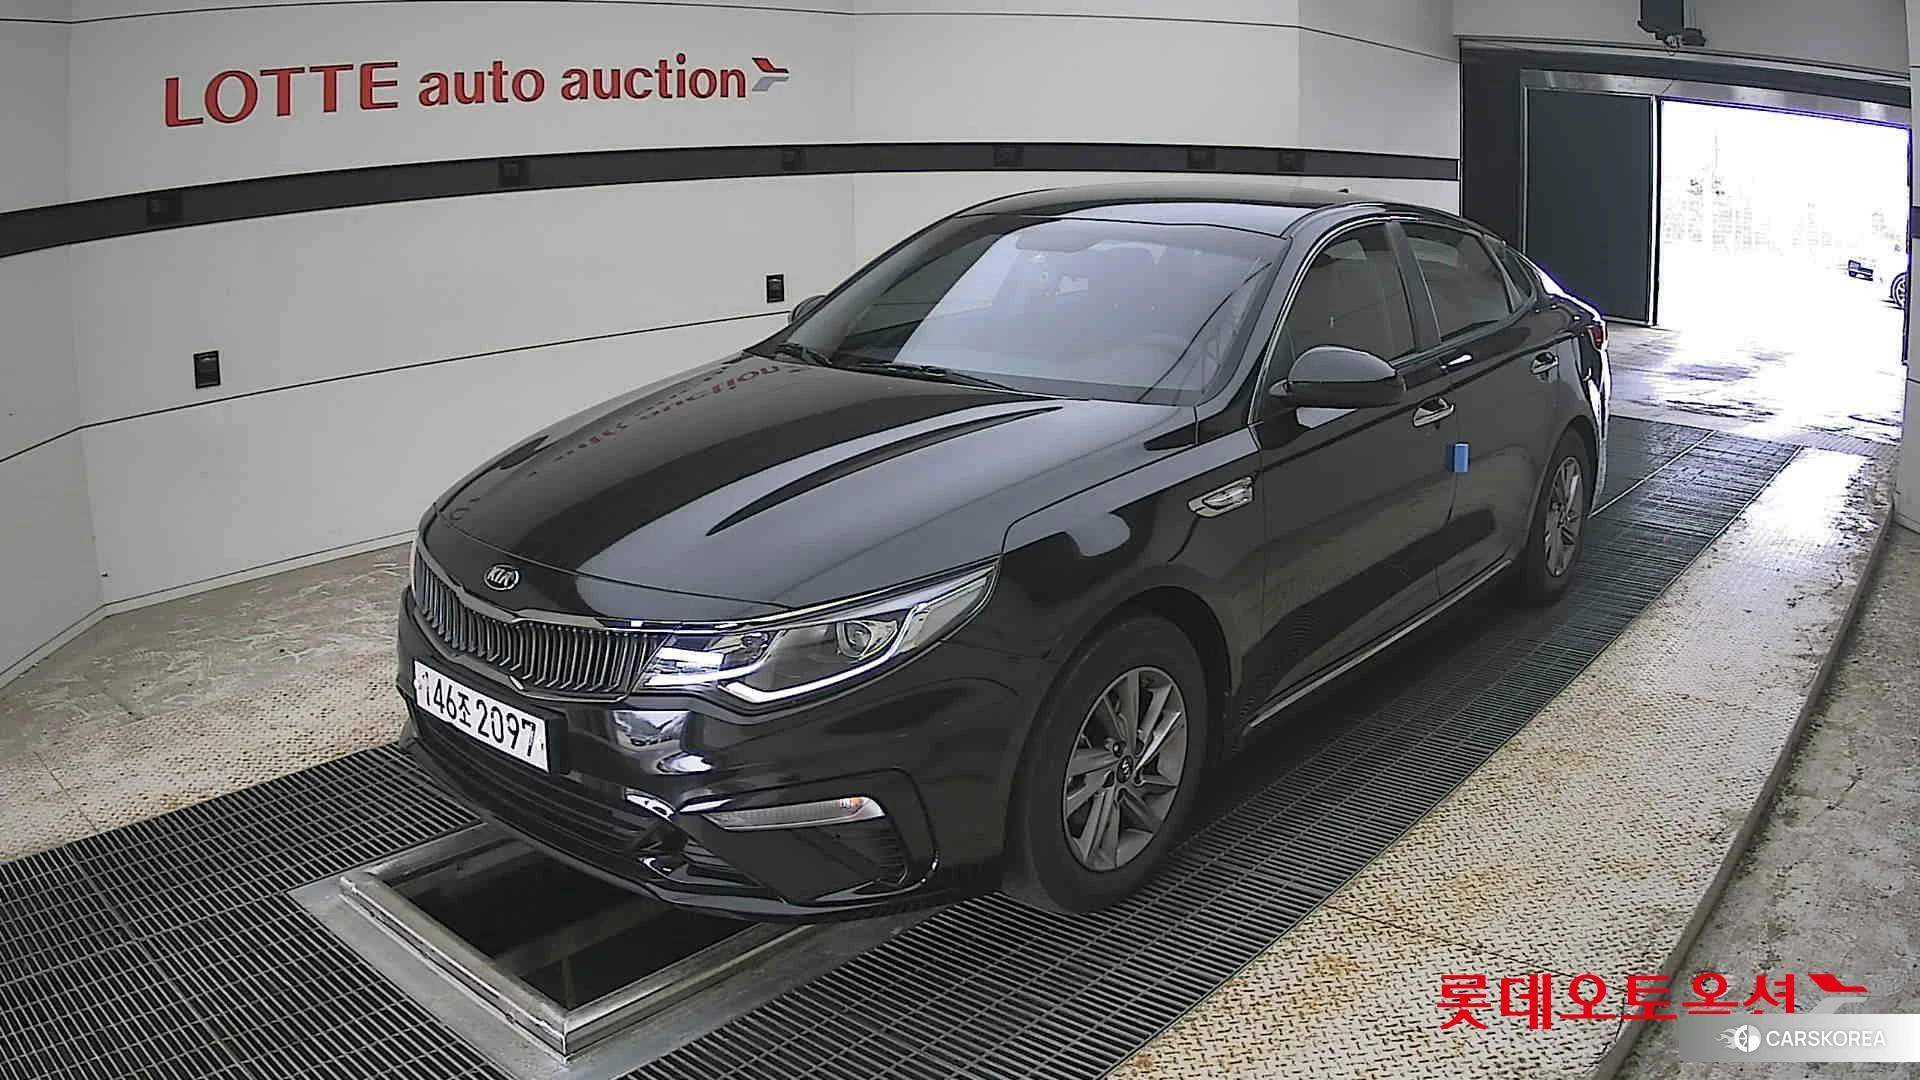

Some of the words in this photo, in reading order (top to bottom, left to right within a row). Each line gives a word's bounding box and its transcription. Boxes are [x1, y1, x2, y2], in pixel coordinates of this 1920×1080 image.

[163, 61, 399, 128] LOTTE
[418, 60, 546, 107] auto
[560, 53, 747, 102] auction
[486, 565, 513, 588] KIA
[476, 699, 537, 757] 2097
